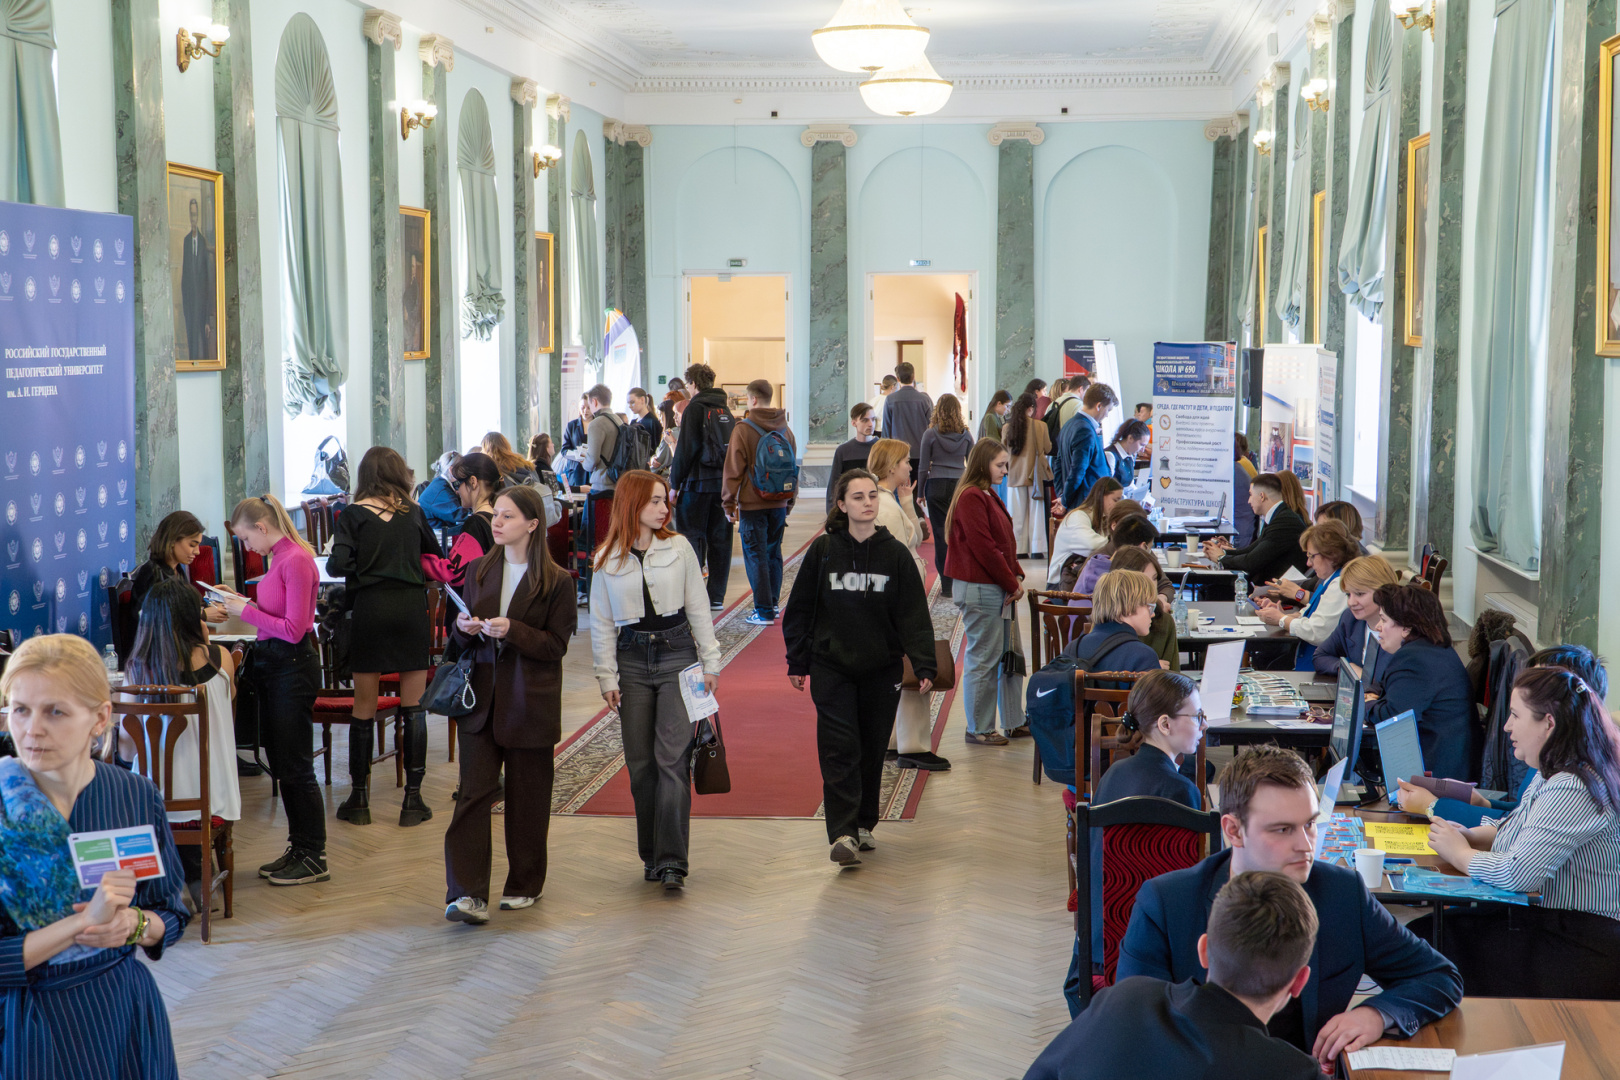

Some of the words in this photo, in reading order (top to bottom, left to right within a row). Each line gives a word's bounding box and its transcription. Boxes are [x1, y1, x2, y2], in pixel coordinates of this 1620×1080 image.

[5, 345, 50, 358] РОССИЙСКИЙ
[51, 344, 107, 359] ГОСУДАРСТВЕННЫЙ
[6, 364, 62, 380] ПЕДАГОГИЧЕСКИЙ
[63, 364, 104, 376] УНИВЕРСИТЕТ
[1155, 365, 1177, 373] ШКОЛА
[1178, 365, 1184, 373] №
[1185, 365, 1196, 374] 690
[31, 385, 58, 398] ГЕРЦЕНА
[1160, 496, 1205, 506] ИНФРАСТРУКТУРА
